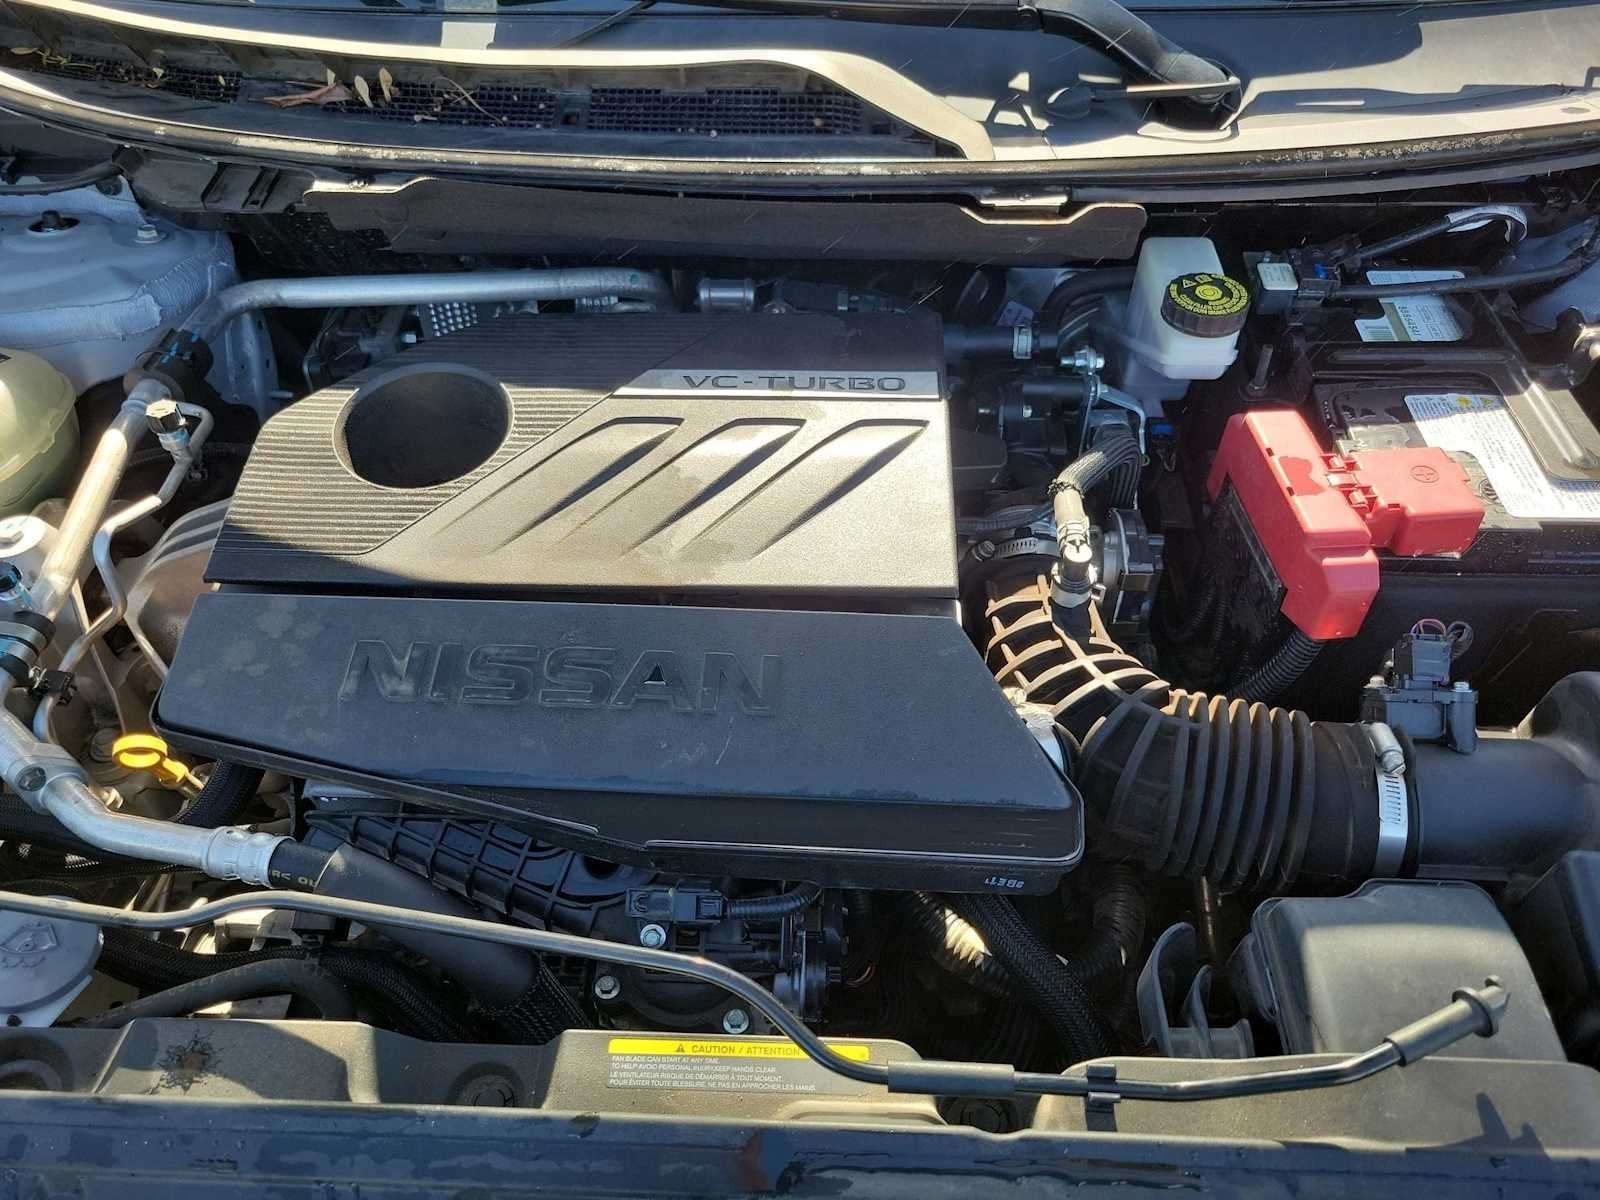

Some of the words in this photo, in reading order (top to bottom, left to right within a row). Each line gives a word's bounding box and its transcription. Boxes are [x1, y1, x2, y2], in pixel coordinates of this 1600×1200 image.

[682, 375, 906, 391] VC-TURBO
[338, 640, 781, 716] NISSAN
[691, 1045, 736, 1054] CAUTION
[746, 1046, 800, 1055] ATTENTION
